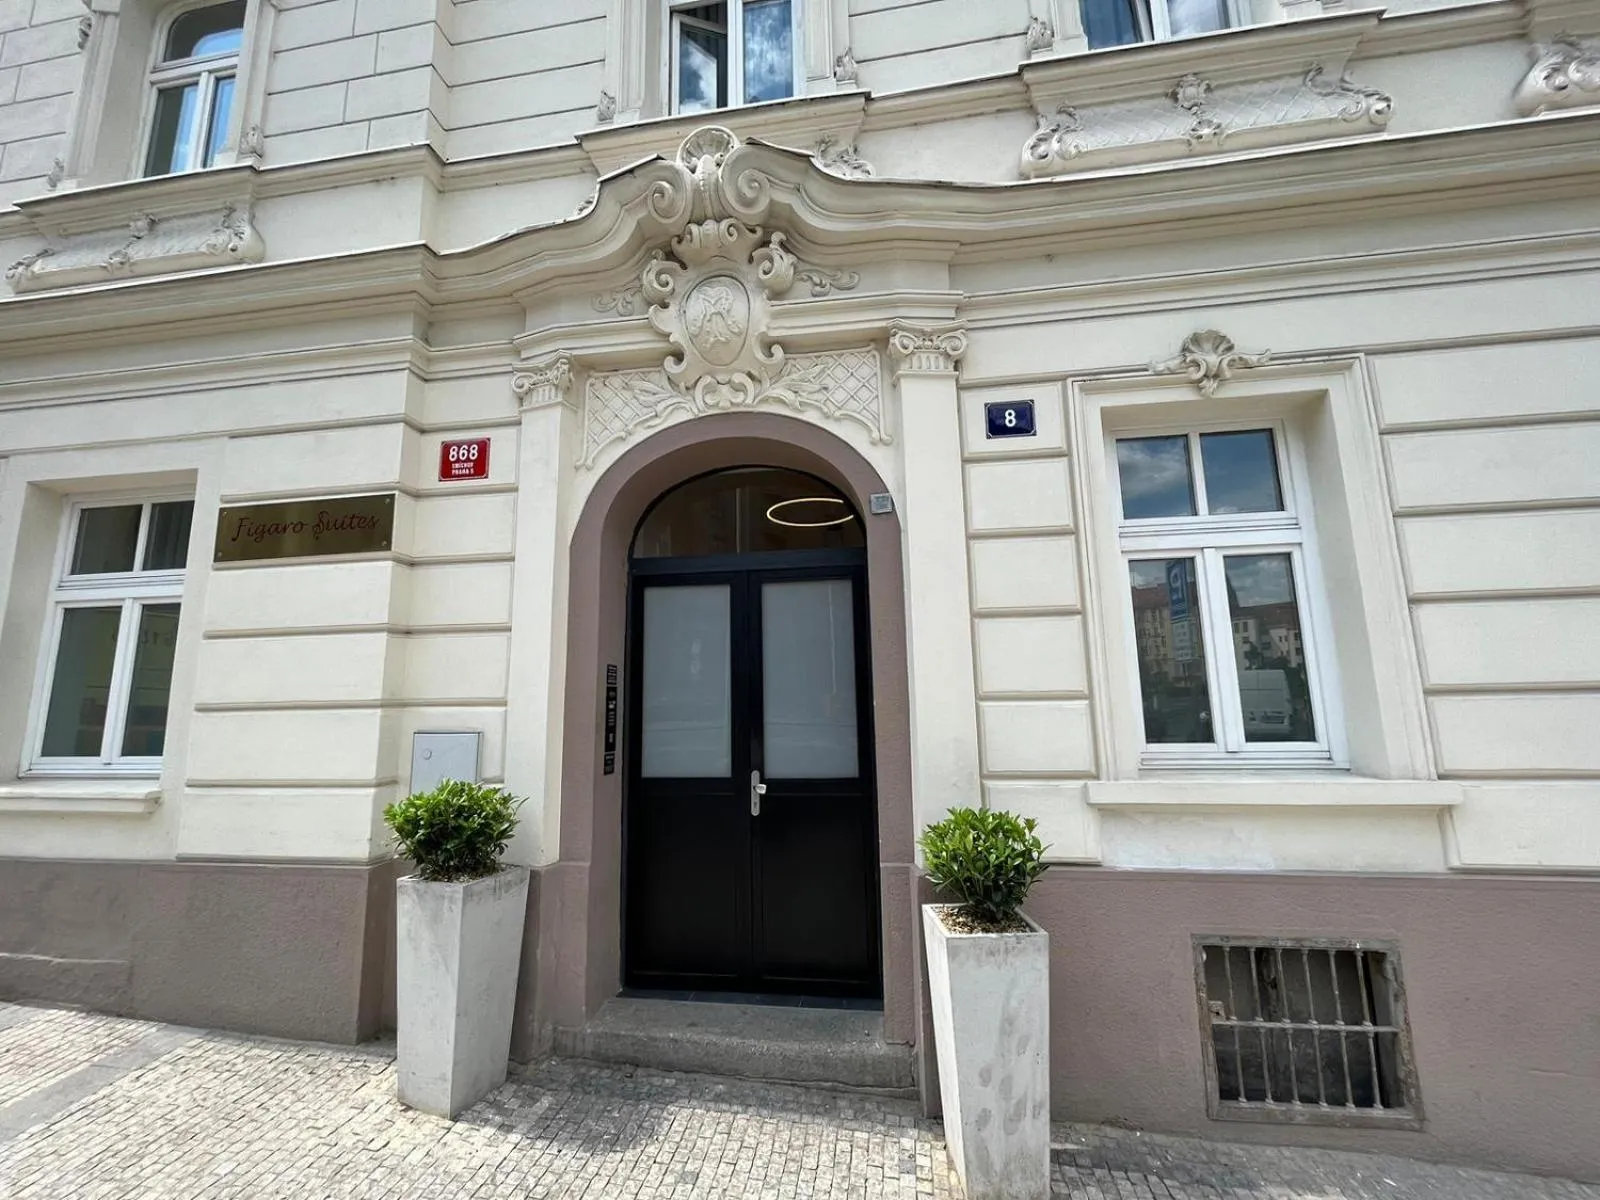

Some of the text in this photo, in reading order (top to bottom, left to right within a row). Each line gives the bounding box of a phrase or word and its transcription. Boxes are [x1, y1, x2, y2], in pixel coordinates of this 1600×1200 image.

[1005, 409, 1016, 427] 8
[449, 444, 478, 461] 868
[232, 510, 380, 544] Figaro Suites
